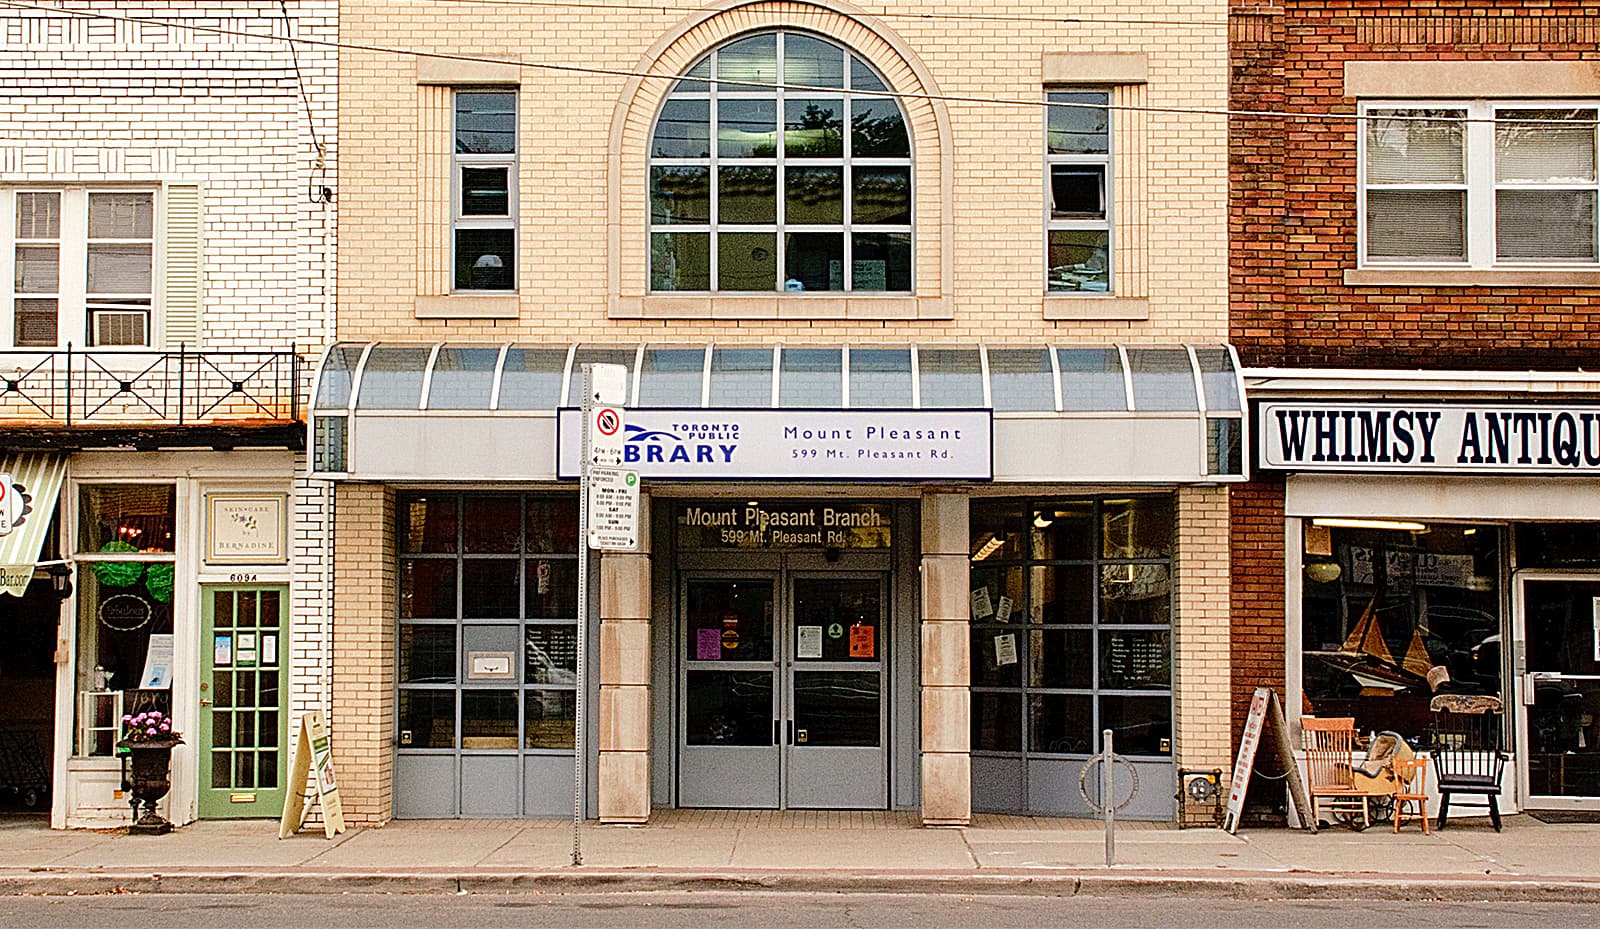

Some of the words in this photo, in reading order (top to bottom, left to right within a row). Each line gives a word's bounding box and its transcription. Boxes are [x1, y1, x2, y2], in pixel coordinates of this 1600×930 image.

[689, 432, 739, 440] PUBLIC
[784, 426, 852, 439] Mount
[866, 426, 961, 439] Pleasant
[1275, 410, 1441, 463] WHIMSY
[624, 445, 737, 462] BRARY
[792, 449, 817, 458] 599
[826, 449, 850, 458] Mt.
[858, 449, 921, 458] Pleasant
[930, 449, 954, 458] Rd.
[686, 507, 737, 526] Mount
[745, 507, 815, 526] Pleasant
[823, 508, 880, 527] Branch
[721, 530, 744, 543] 599
[749, 530, 767, 543] Mt.
[772, 530, 821, 543] Pleasant
[827, 530, 846, 543] Rd.
[219, 542, 274, 550] BERNADINE
[230, 573, 257, 582] 609A
